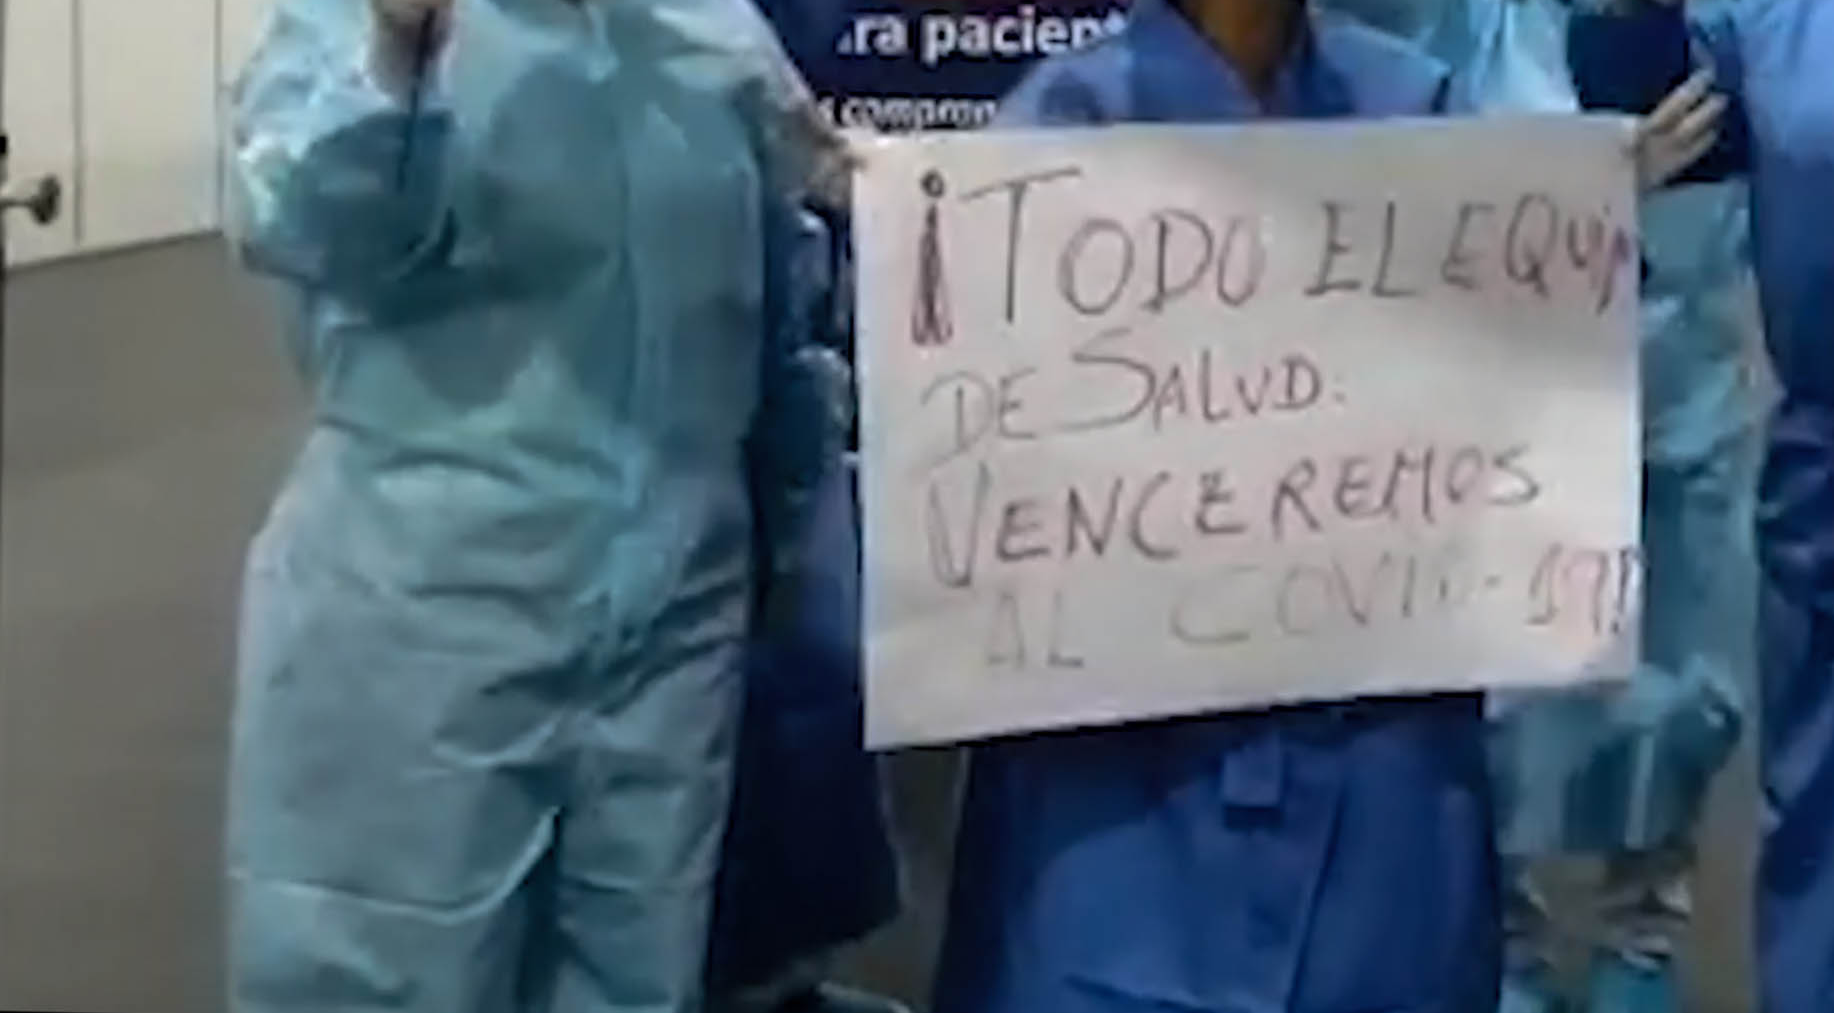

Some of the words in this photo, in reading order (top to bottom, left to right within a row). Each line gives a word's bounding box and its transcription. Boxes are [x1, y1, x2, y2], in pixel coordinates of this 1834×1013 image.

[1304, 198, 1416, 298] EL
[918, 366, 1038, 472] DE
[928, 444, 1540, 588] VENCEREMOS
[984, 592, 1086, 670] AL
